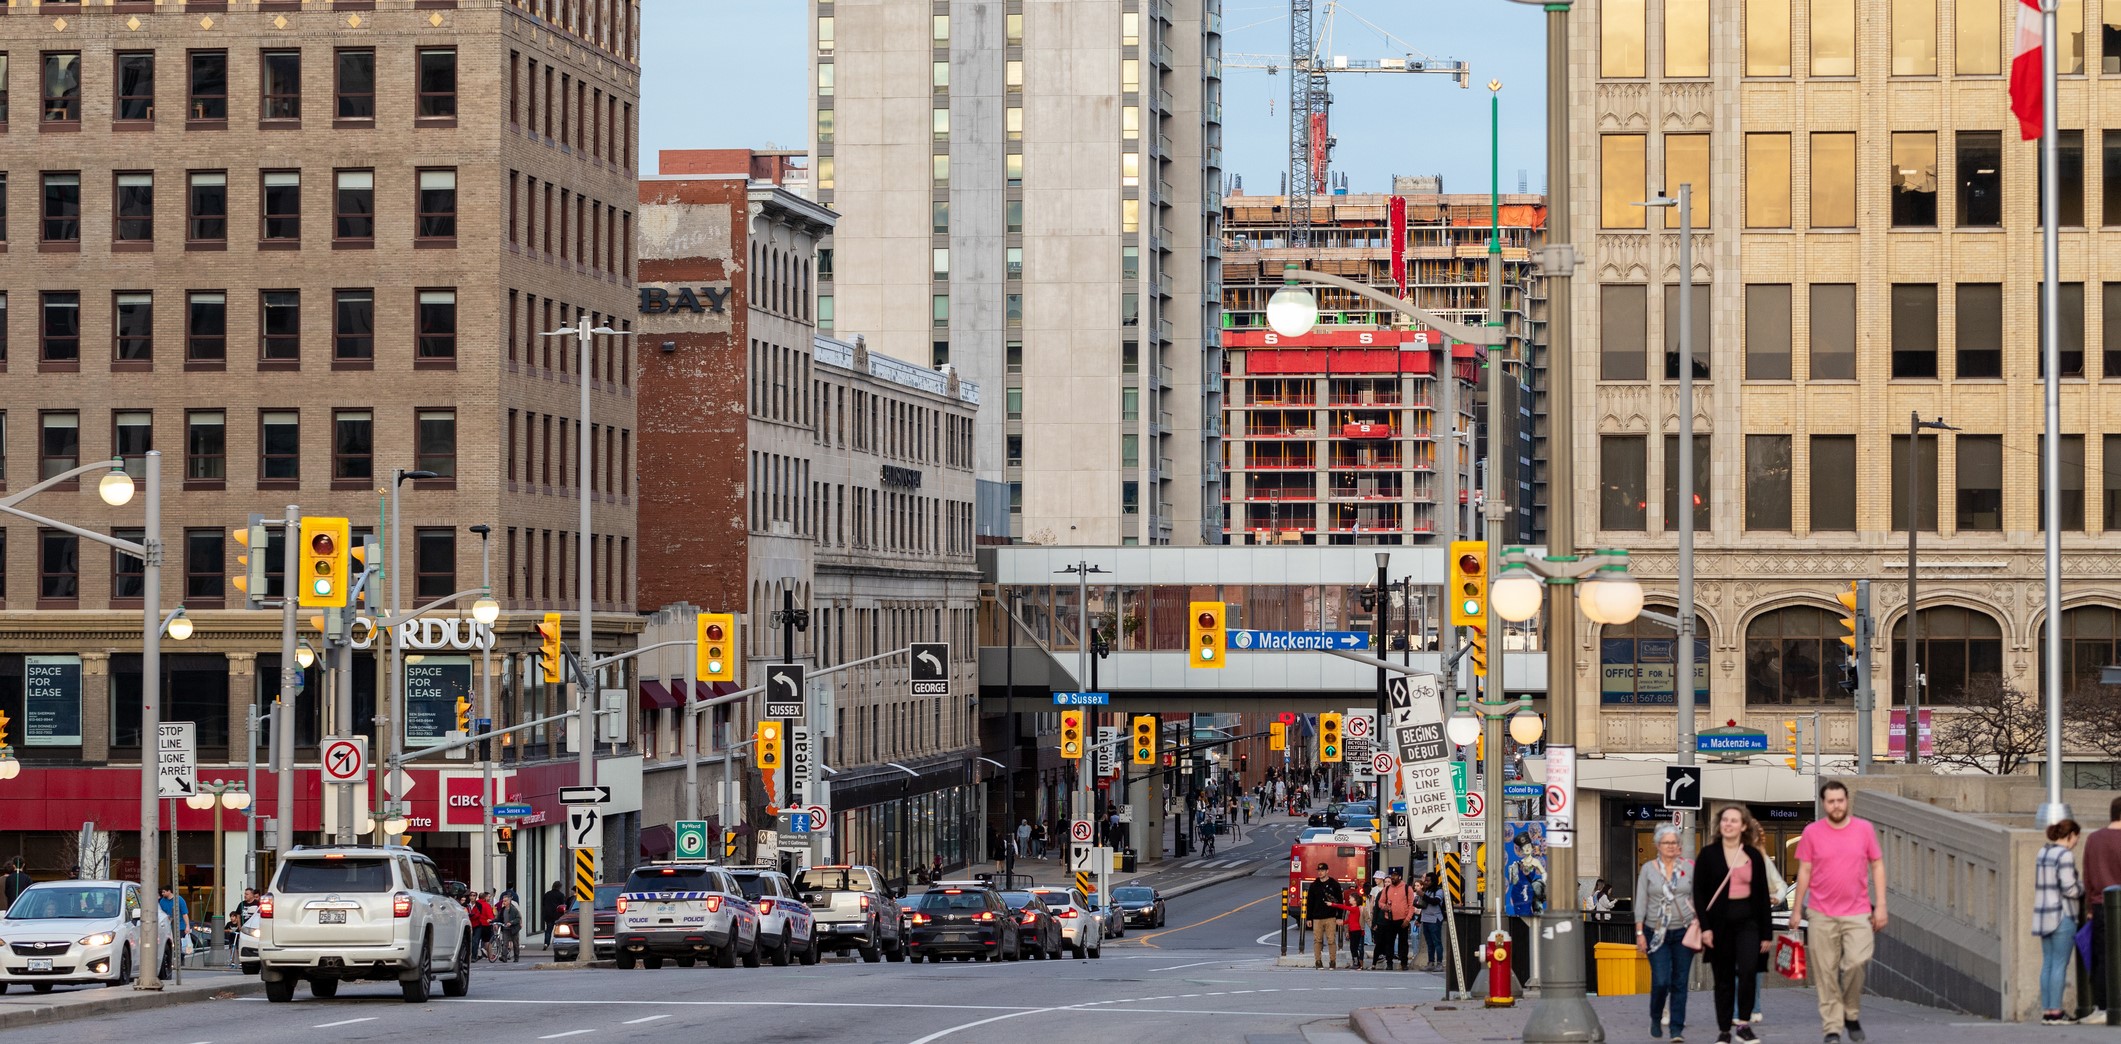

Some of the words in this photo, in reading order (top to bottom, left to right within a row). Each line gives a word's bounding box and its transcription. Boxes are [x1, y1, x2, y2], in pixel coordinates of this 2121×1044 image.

[640, 286, 733, 313] BAY
[1259, 631, 1334, 649] Mackenzie
[28, 667, 62, 676] SPACE
[408, 667, 442, 676] SPACE
[1605, 668, 1643, 678] OFFICE
[1668, 667, 1704, 678] LSE
[28, 677, 51, 686] FOR
[408, 678, 431, 687] FOR
[28, 688, 62, 697] LEASE
[408, 688, 442, 697] LEASE
[914, 682, 946, 693] GEORGE
[1071, 693, 1103, 704] Sussex
[1620, 694, 1673, 703] 613-567-805
[769, 705, 800, 715] SUSSEX
[159, 726, 183, 736] STOP
[1402, 725, 1439, 744] BEGINS
[161, 739, 182, 748] LINE
[1710, 737, 1750, 748] Mackenzie
[1407, 744, 1439, 760] DÉBUT
[158, 753, 185, 763] LIGNE
[1411, 767, 1440, 779] STOP
[1415, 778, 1440, 790] LINE
[449, 795, 478, 806] CIBC
[1413, 791, 1446, 804] LIGNE
[1411, 802, 1452, 816] D'ARRET
[1770, 809, 1798, 817] Rideau
[409, 816, 432, 827] ntre
